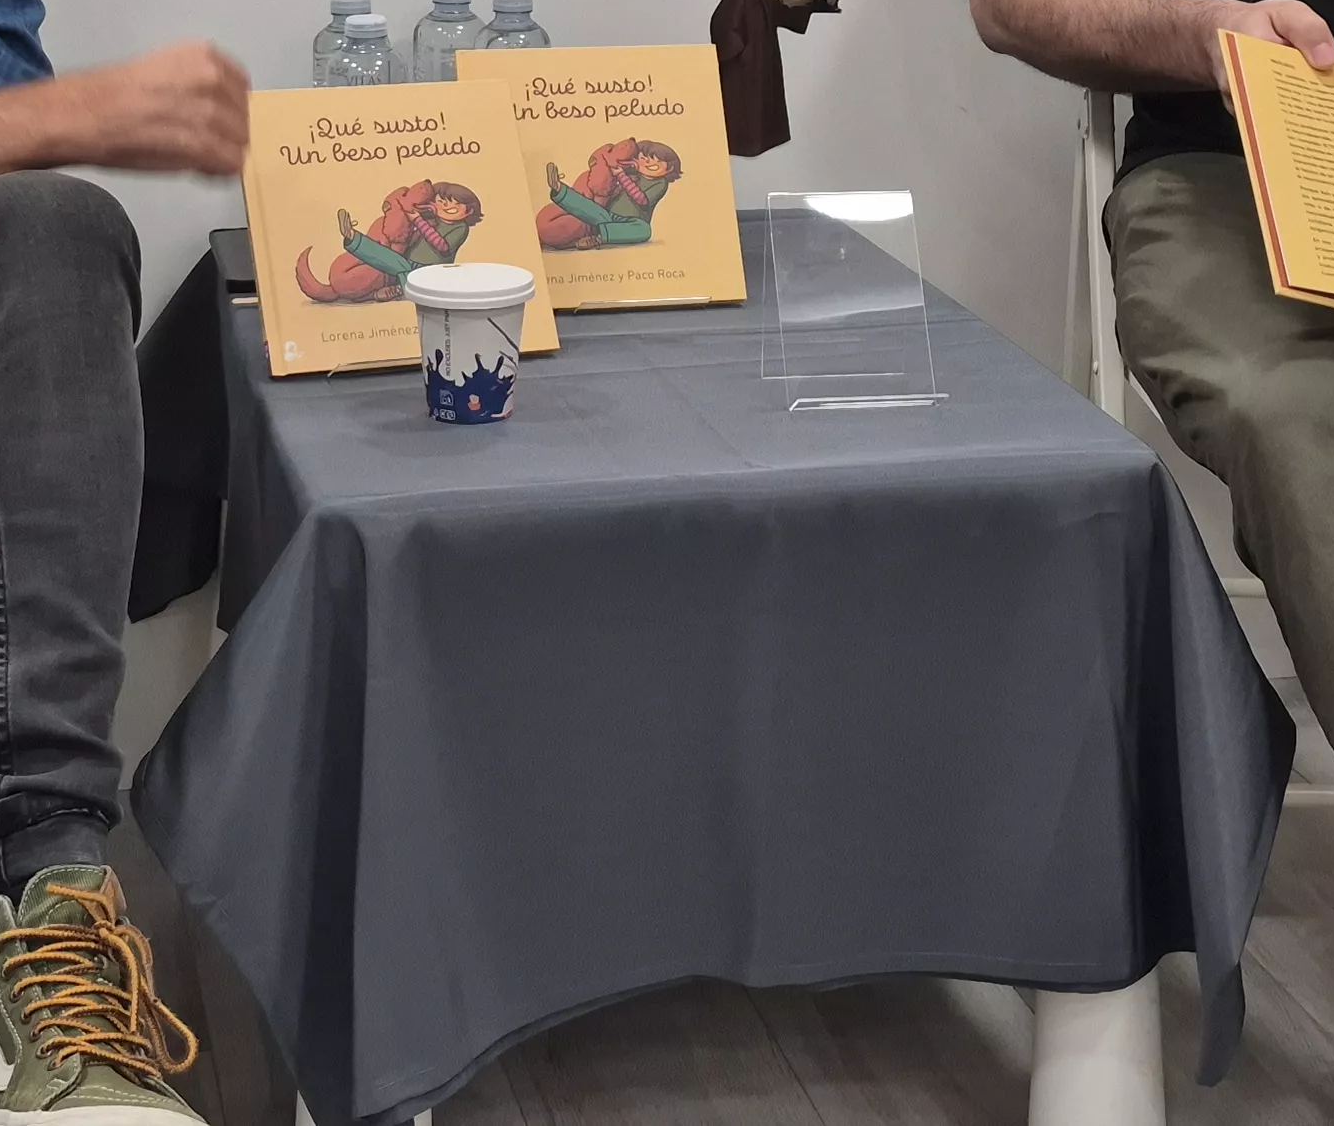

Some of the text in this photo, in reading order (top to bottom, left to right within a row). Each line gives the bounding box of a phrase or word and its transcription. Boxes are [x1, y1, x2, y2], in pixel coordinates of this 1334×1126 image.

[525, 74, 654, 101] ¡Qué susto!
[545, 100, 595, 118] beso
[605, 98, 685, 123] peludo
[309, 112, 447, 144] ¡Qué susto!
[279, 136, 482, 166] Un beso peludo
[568, 273, 615, 284] Jiménez
[619, 274, 624, 284] y
[627, 270, 654, 280] Paco
[659, 269, 685, 279] Roca
[321, 325, 419, 342] Lorena Jiménez
